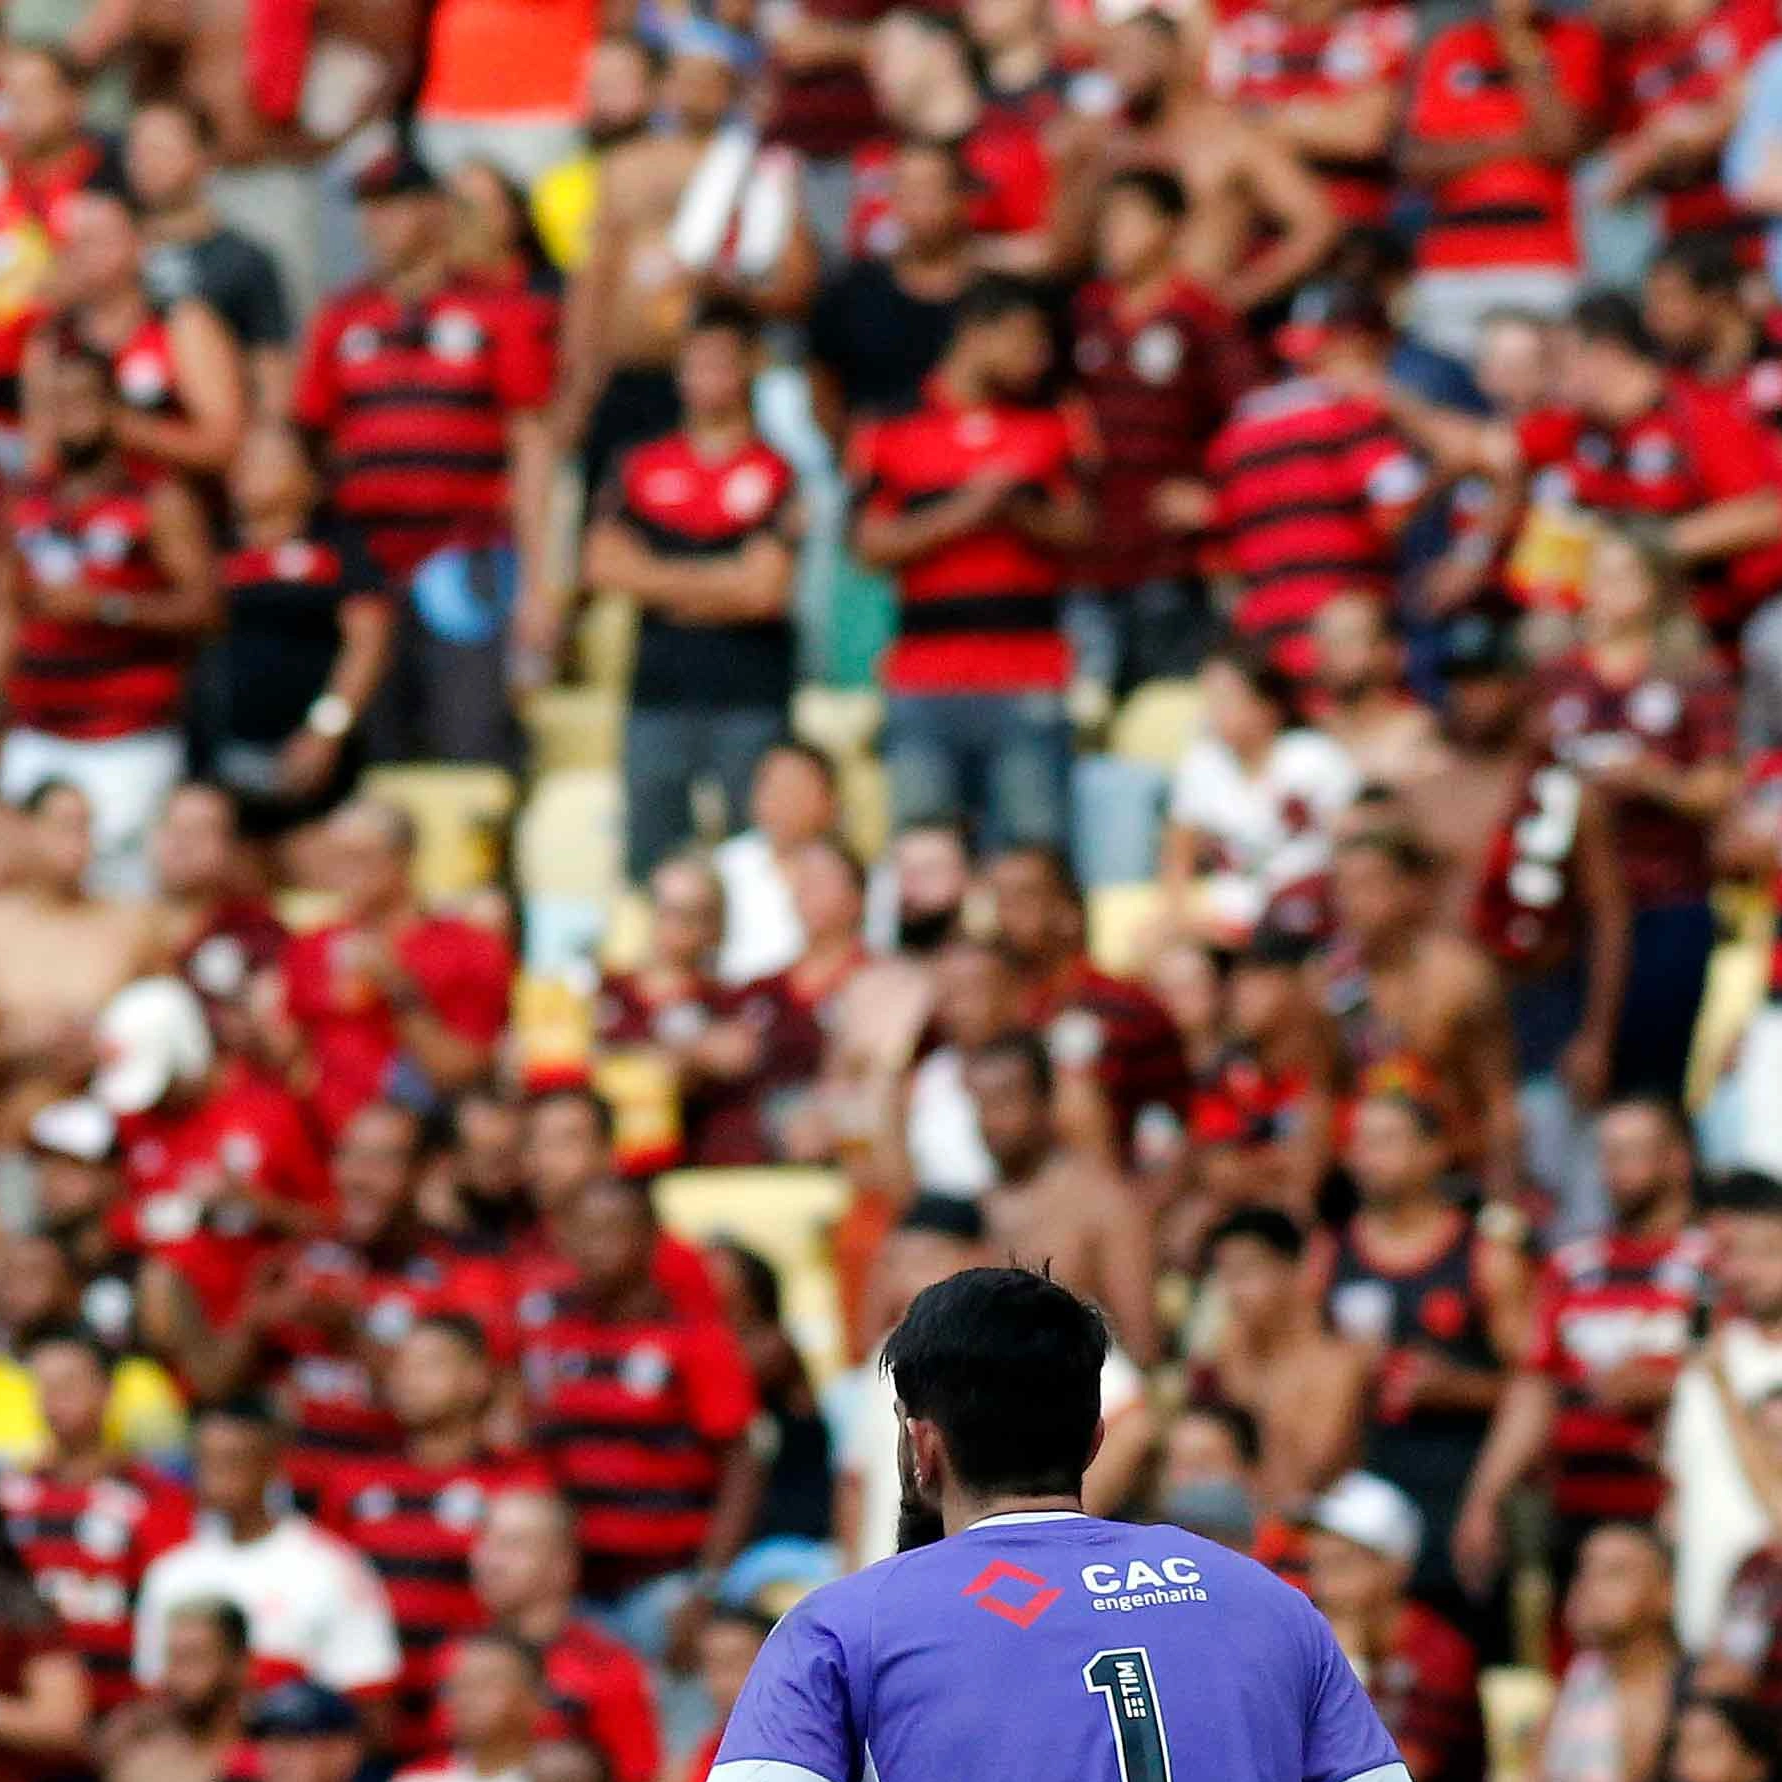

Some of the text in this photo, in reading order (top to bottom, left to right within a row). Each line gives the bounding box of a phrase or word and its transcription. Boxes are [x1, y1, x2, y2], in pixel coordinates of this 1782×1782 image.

[1081, 1557, 1201, 1595] CAC
[1092, 1586, 1208, 1612] engenharia
[1114, 1661, 1142, 1697] TIM
